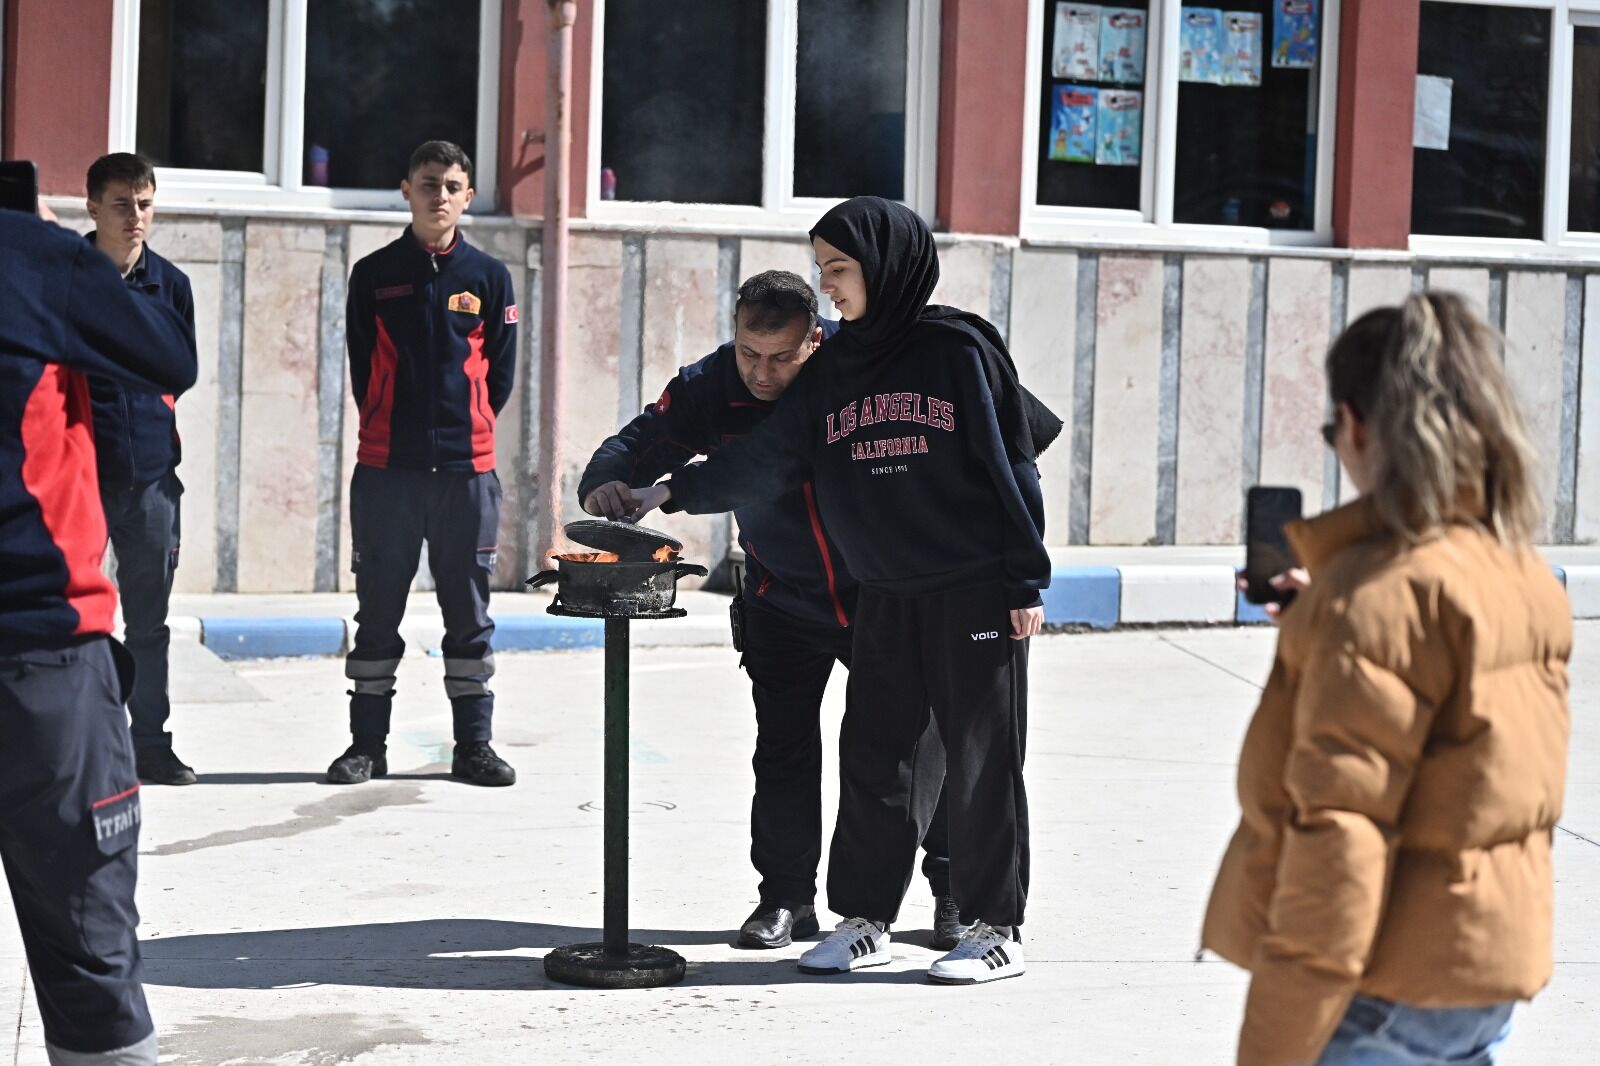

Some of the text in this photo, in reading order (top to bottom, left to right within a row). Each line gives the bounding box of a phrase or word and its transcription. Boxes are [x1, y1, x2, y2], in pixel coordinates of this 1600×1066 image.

[827, 393, 955, 444] LOS ANGELES
[852, 436, 929, 460] CALIFORNIA
[871, 466, 893, 475] SINCE
[971, 631, 998, 640] VOID
